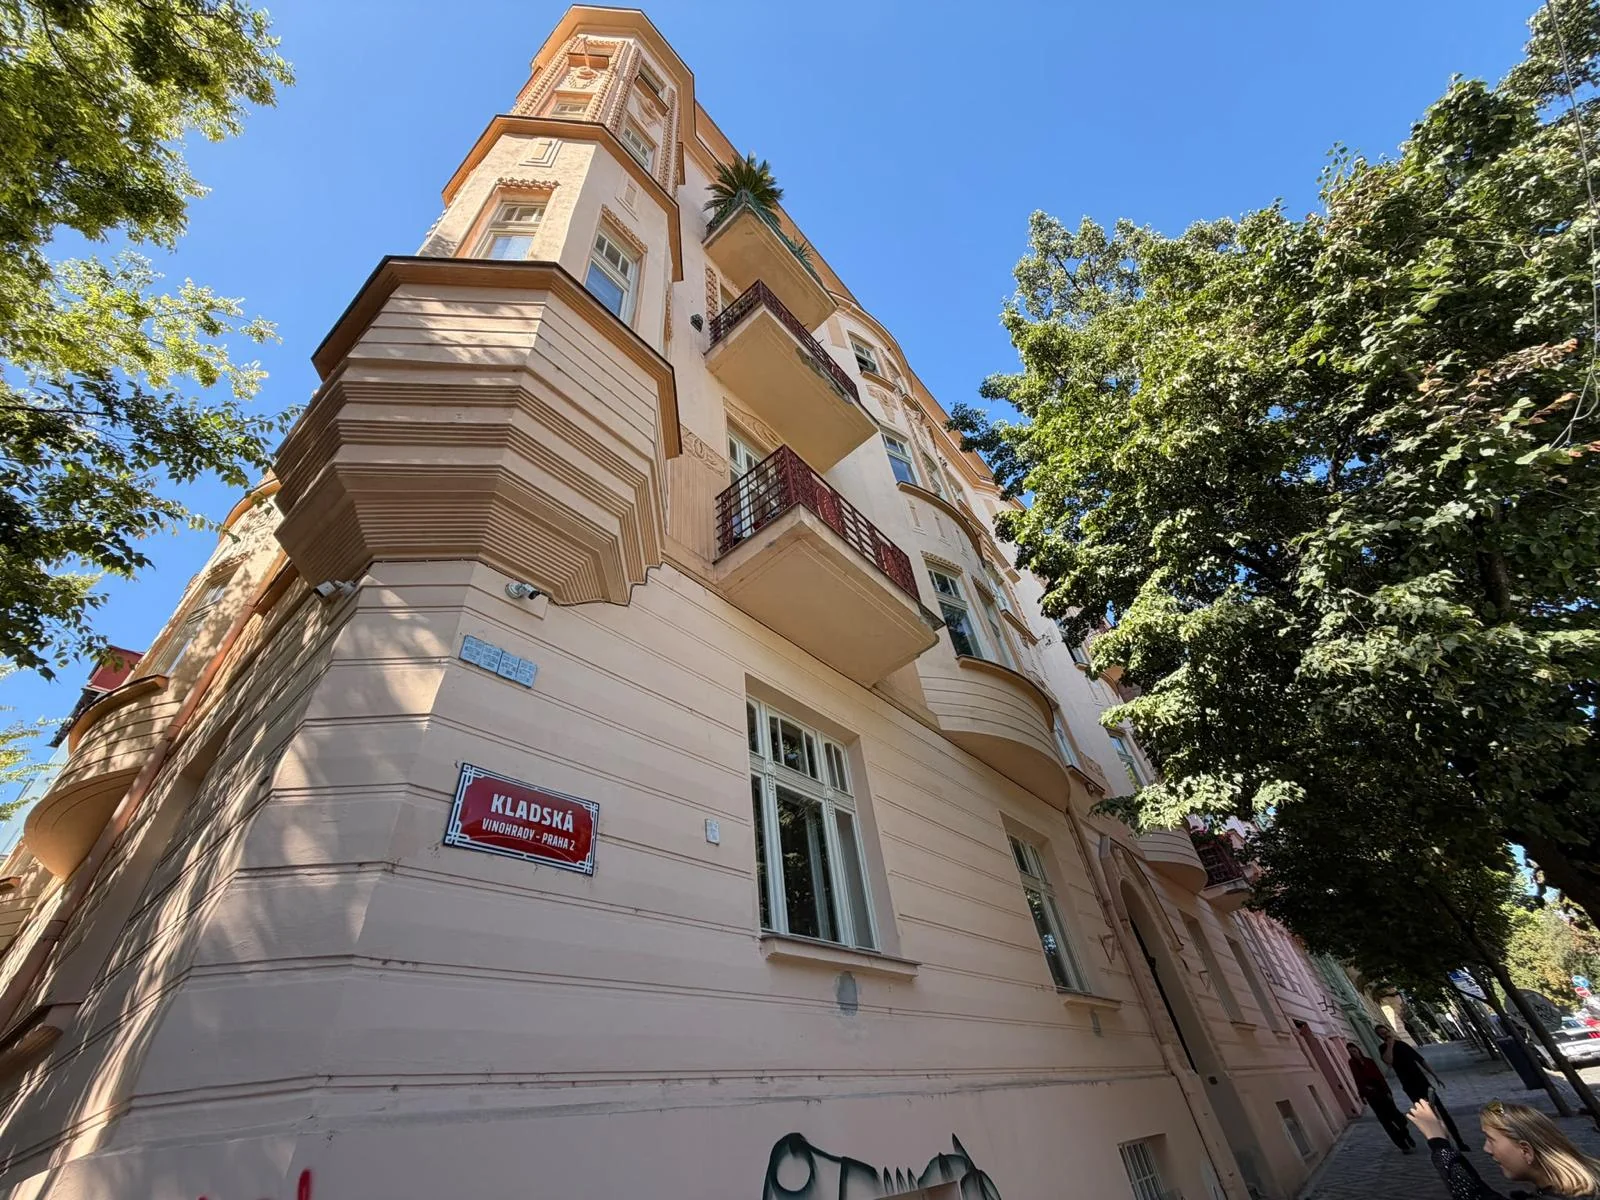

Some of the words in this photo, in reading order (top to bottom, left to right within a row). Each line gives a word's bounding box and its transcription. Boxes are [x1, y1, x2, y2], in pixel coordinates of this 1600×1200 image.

[490, 793, 574, 833] KLADSKÁ
[482, 818, 535, 841] VINOHRADY
[541, 832, 569, 849] PRAHA
[569, 840, 576, 851] 2
